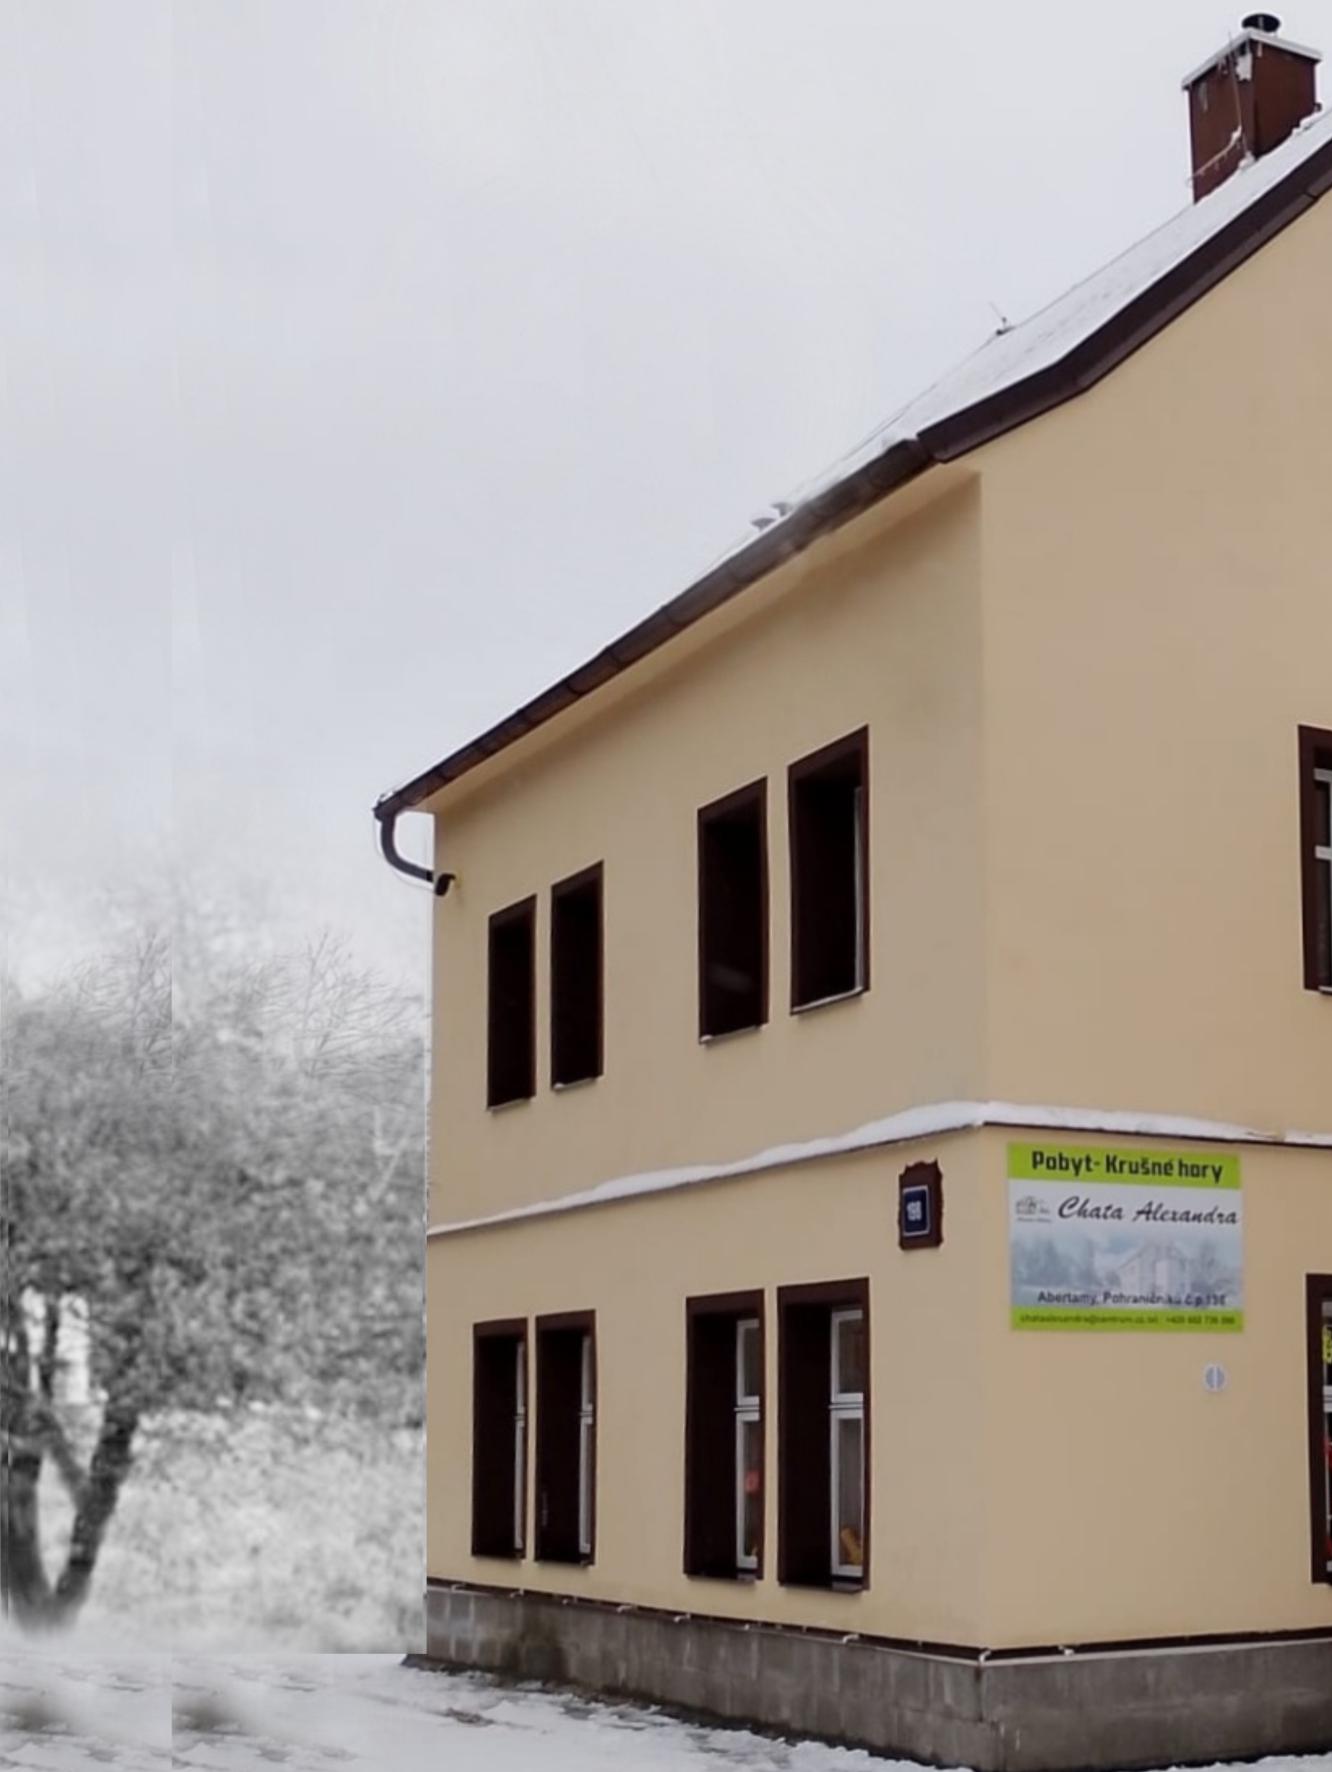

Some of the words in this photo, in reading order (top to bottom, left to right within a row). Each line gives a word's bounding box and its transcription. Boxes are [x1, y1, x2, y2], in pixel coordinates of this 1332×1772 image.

[1105, 1153, 1173, 1176] Krušné
[1178, 1159, 1223, 1184] hory
[1058, 1196, 1124, 1221] Chata
[1132, 1201, 1238, 1225] Alexandra
